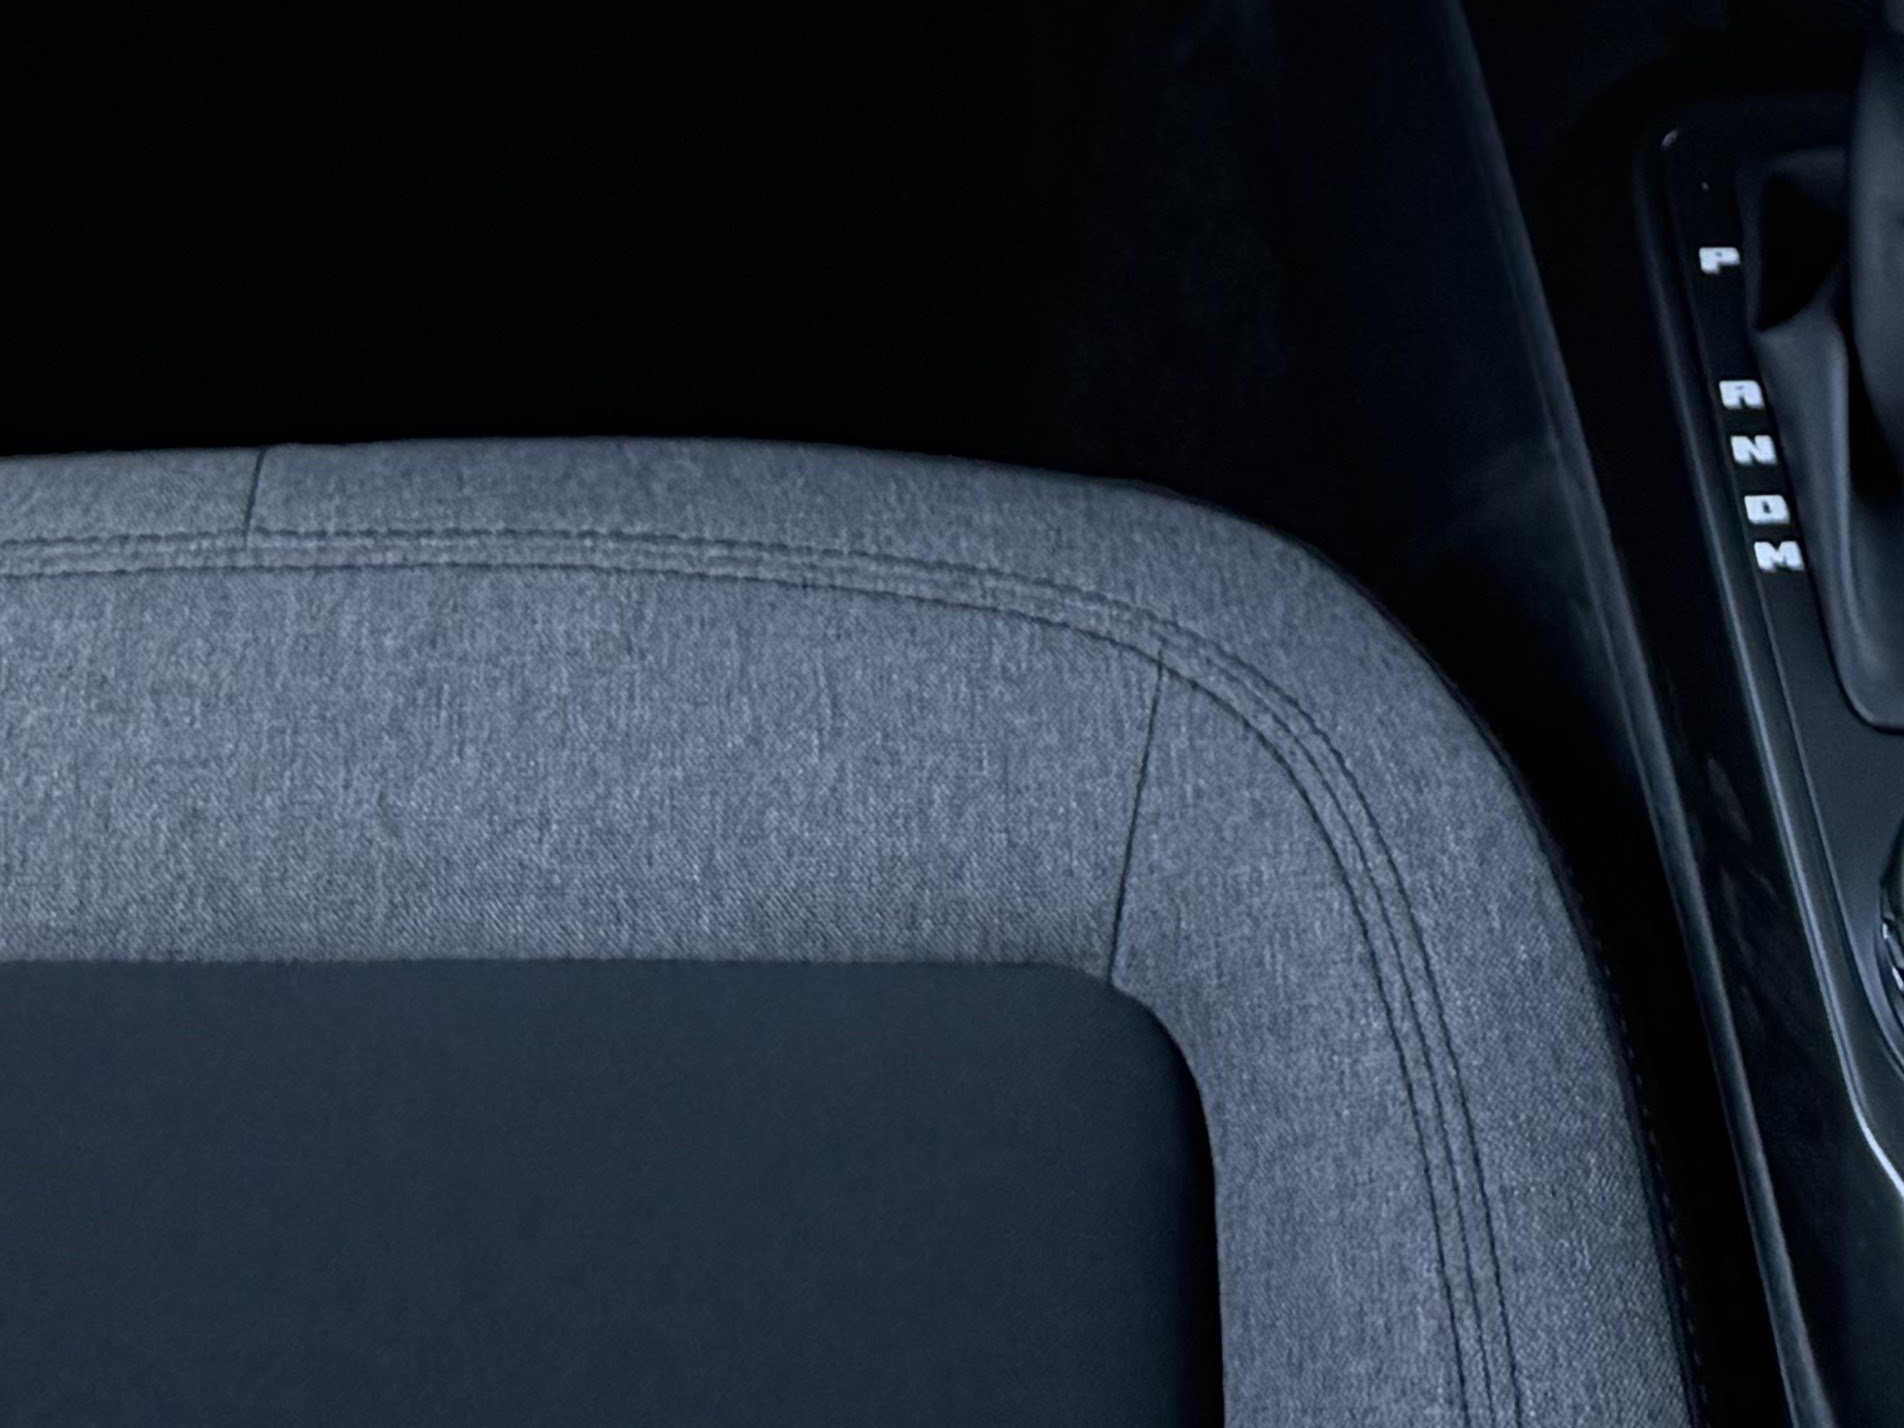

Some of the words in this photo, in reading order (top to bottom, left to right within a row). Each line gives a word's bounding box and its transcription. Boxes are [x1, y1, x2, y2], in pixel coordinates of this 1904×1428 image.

[1698, 246, 1741, 274] P
[1729, 434, 1778, 465] N
[1743, 494, 1791, 525] D
[1753, 540, 1805, 573] M
